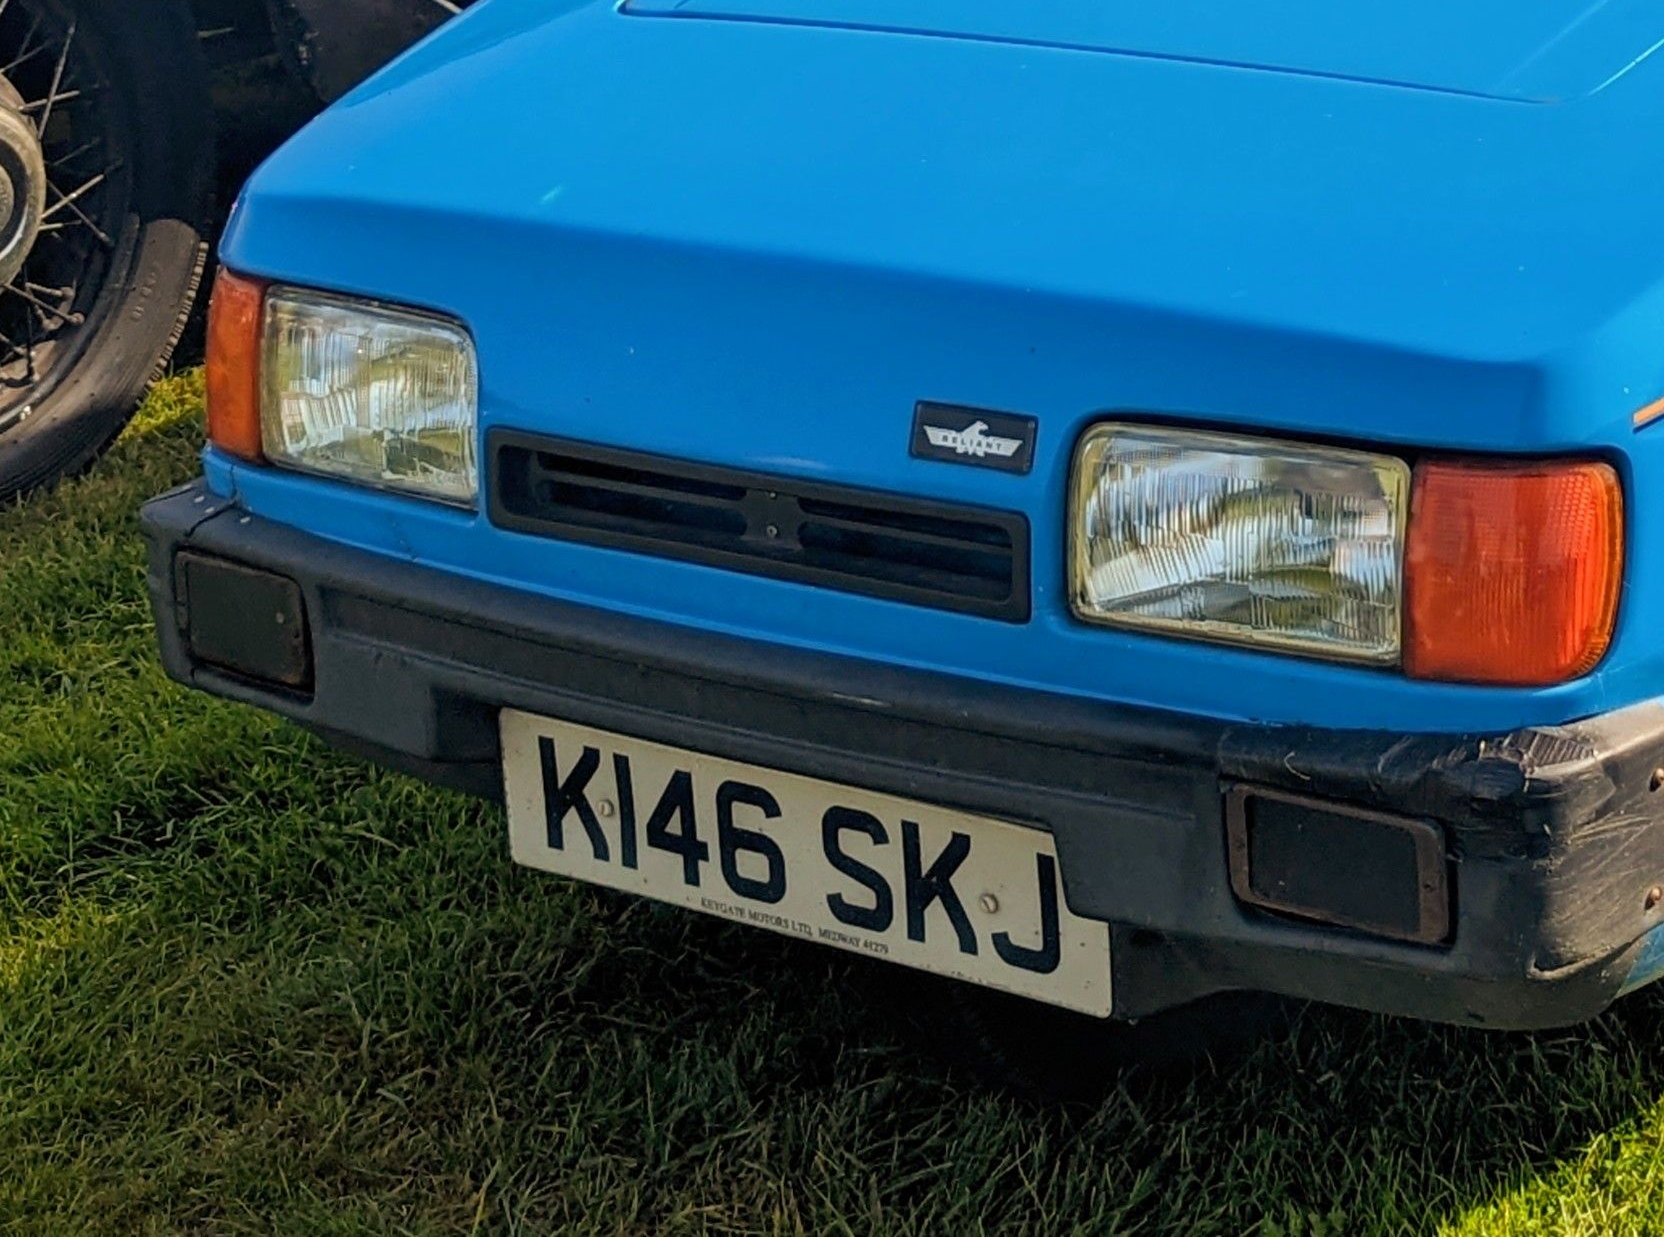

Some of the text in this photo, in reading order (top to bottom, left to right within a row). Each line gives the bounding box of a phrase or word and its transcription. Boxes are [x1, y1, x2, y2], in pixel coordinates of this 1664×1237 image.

[941, 434, 1002, 452] RELIANT
[538, 735, 1061, 974] K146 SKJ
[747, 909, 790, 930] MOTORS
